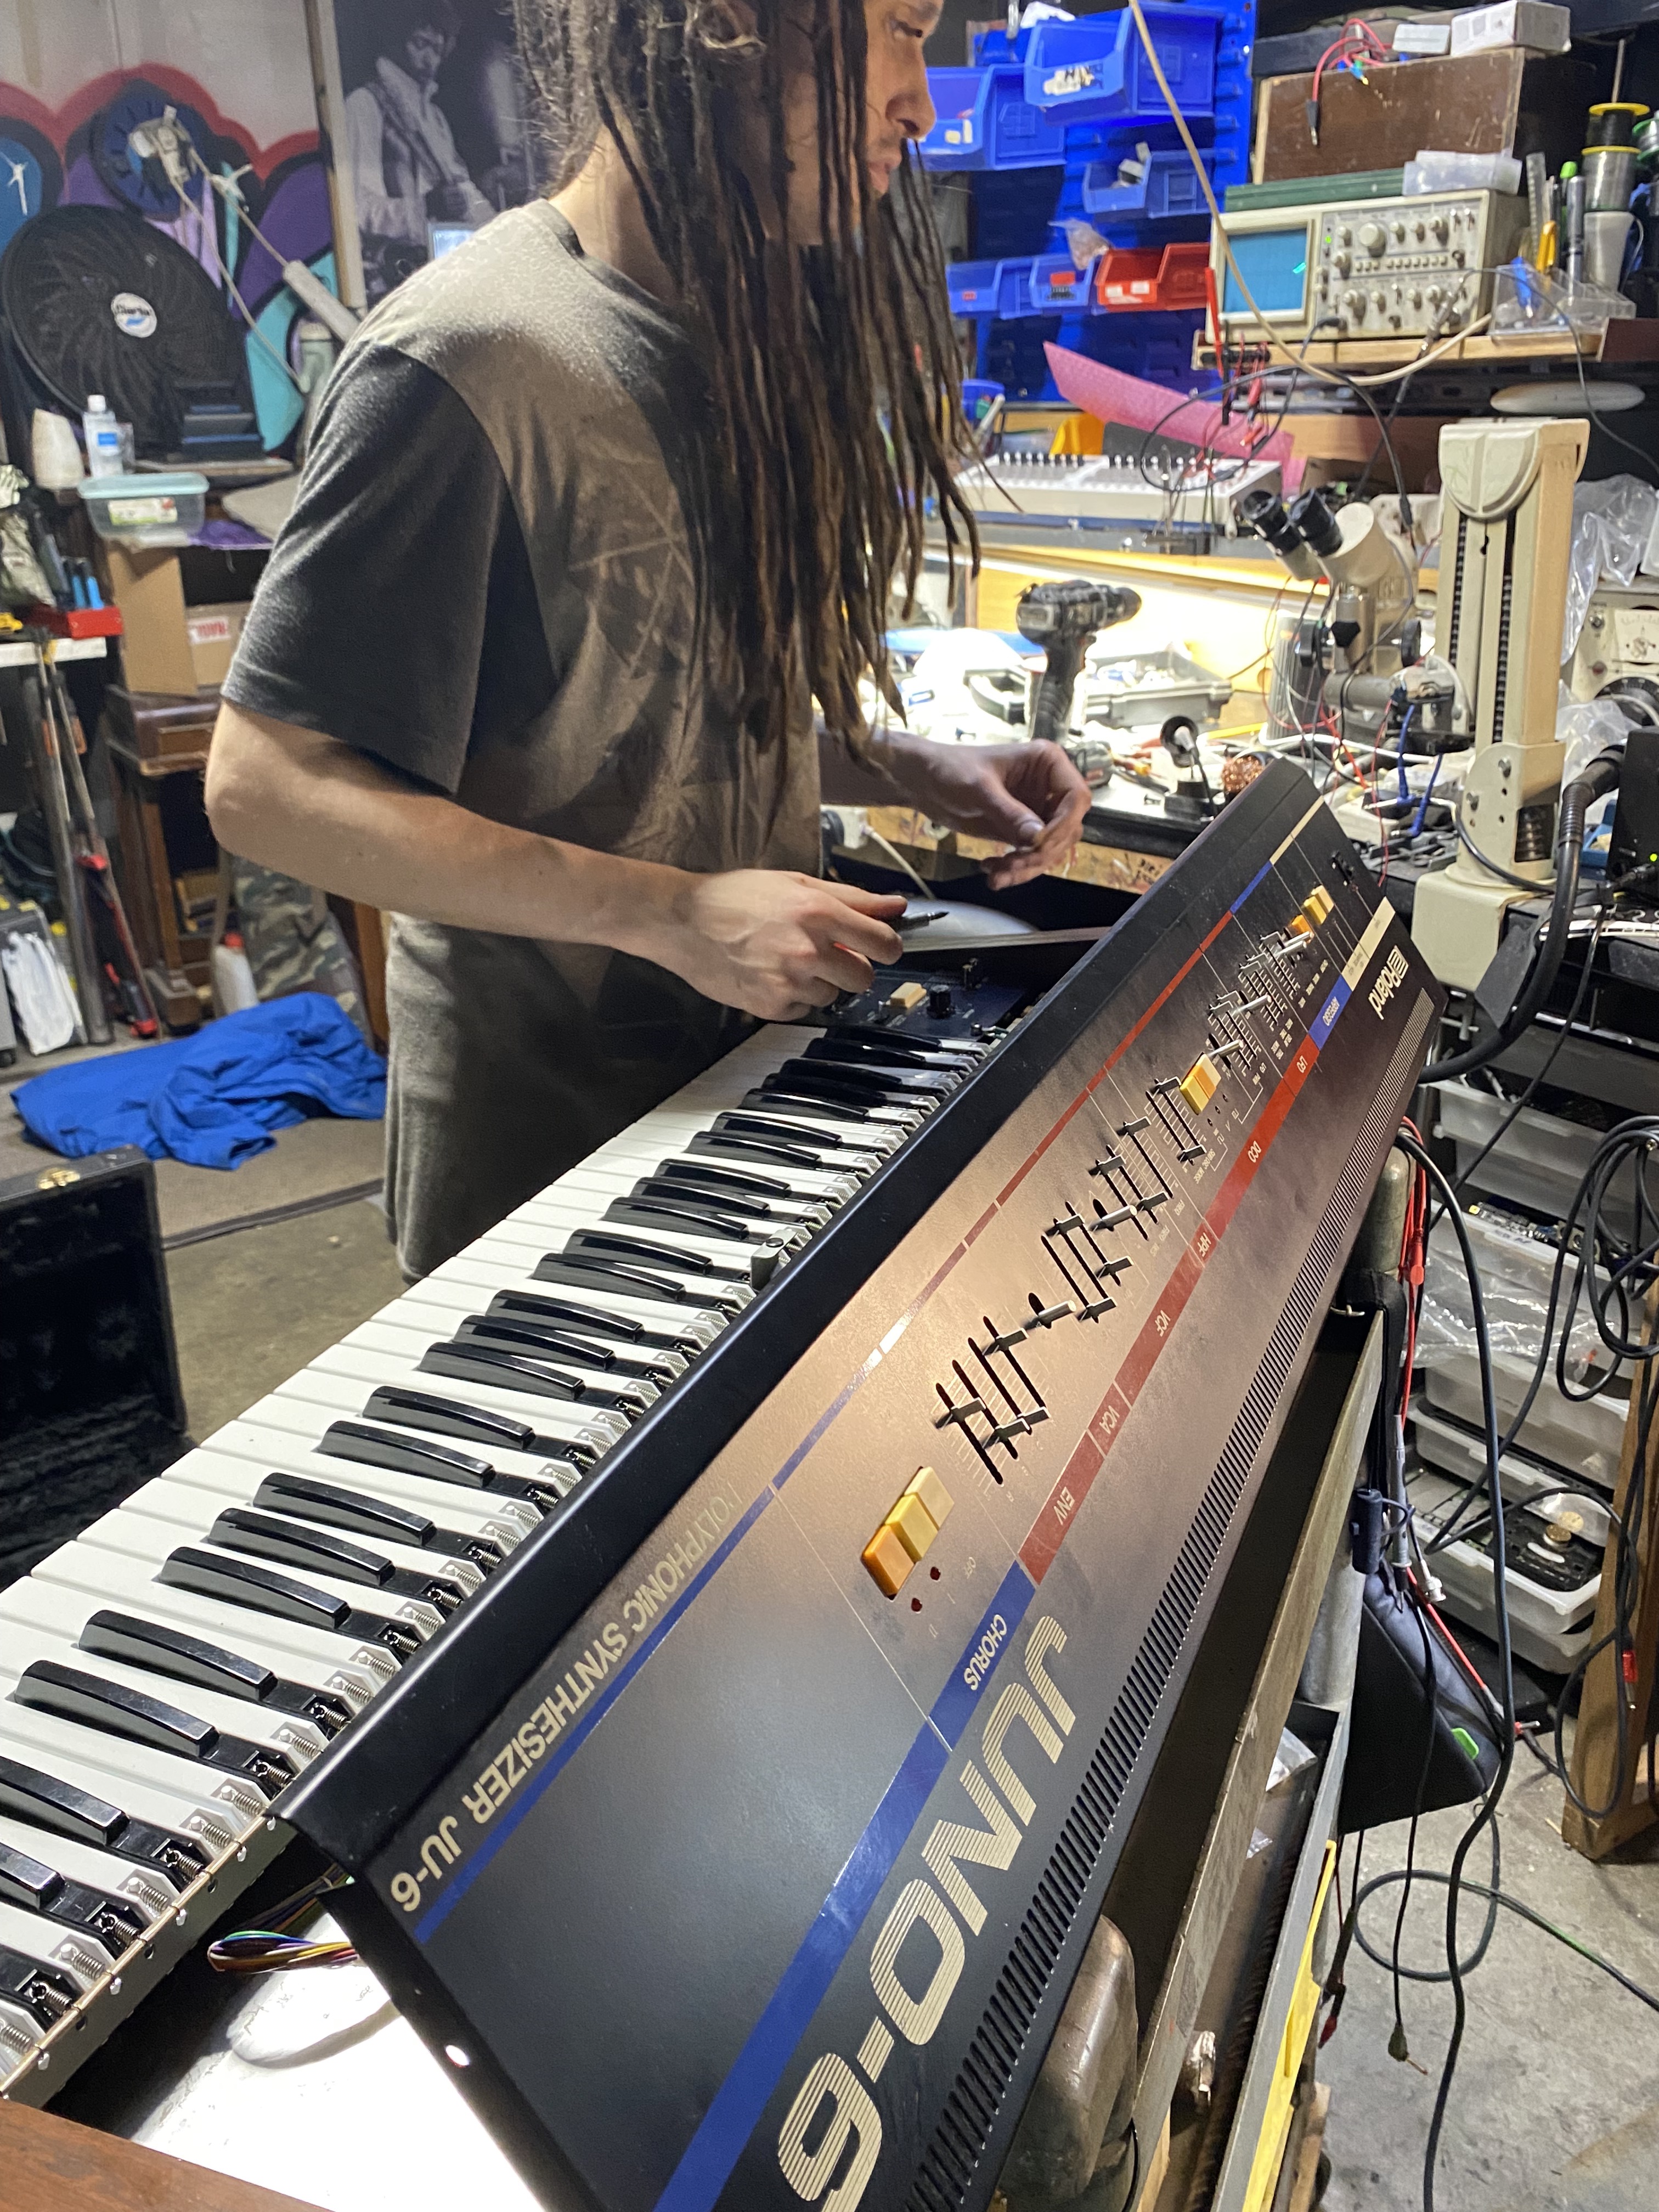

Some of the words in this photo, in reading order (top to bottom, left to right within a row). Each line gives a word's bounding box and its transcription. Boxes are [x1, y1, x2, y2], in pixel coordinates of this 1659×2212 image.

[1368, 966, 1401, 1020] Roland
[1323, 996, 1340, 1026] ARPEGGIO
[1296, 1055, 1308, 1073] LFO
[1248, 1141, 1262, 1163] DCO
[1174, 1199, 1185, 1216] FREQ
[1159, 1224, 1170, 1242] FREQ
[1197, 1232, 1212, 1257] HPF
[1155, 1310, 1171, 1337] VCF
[1099, 1405, 1120, 1435] VCA
[1053, 1486, 1075, 1526] ENV
[964, 1556, 977, 1579] OFF
[963, 1614, 1007, 1691] CHORUS
[461, 1622, 629, 1824] SYNTHESIZER
[390, 1815, 462, 1912] JU-6
[777, 1615, 1077, 2212] JUNO-6
